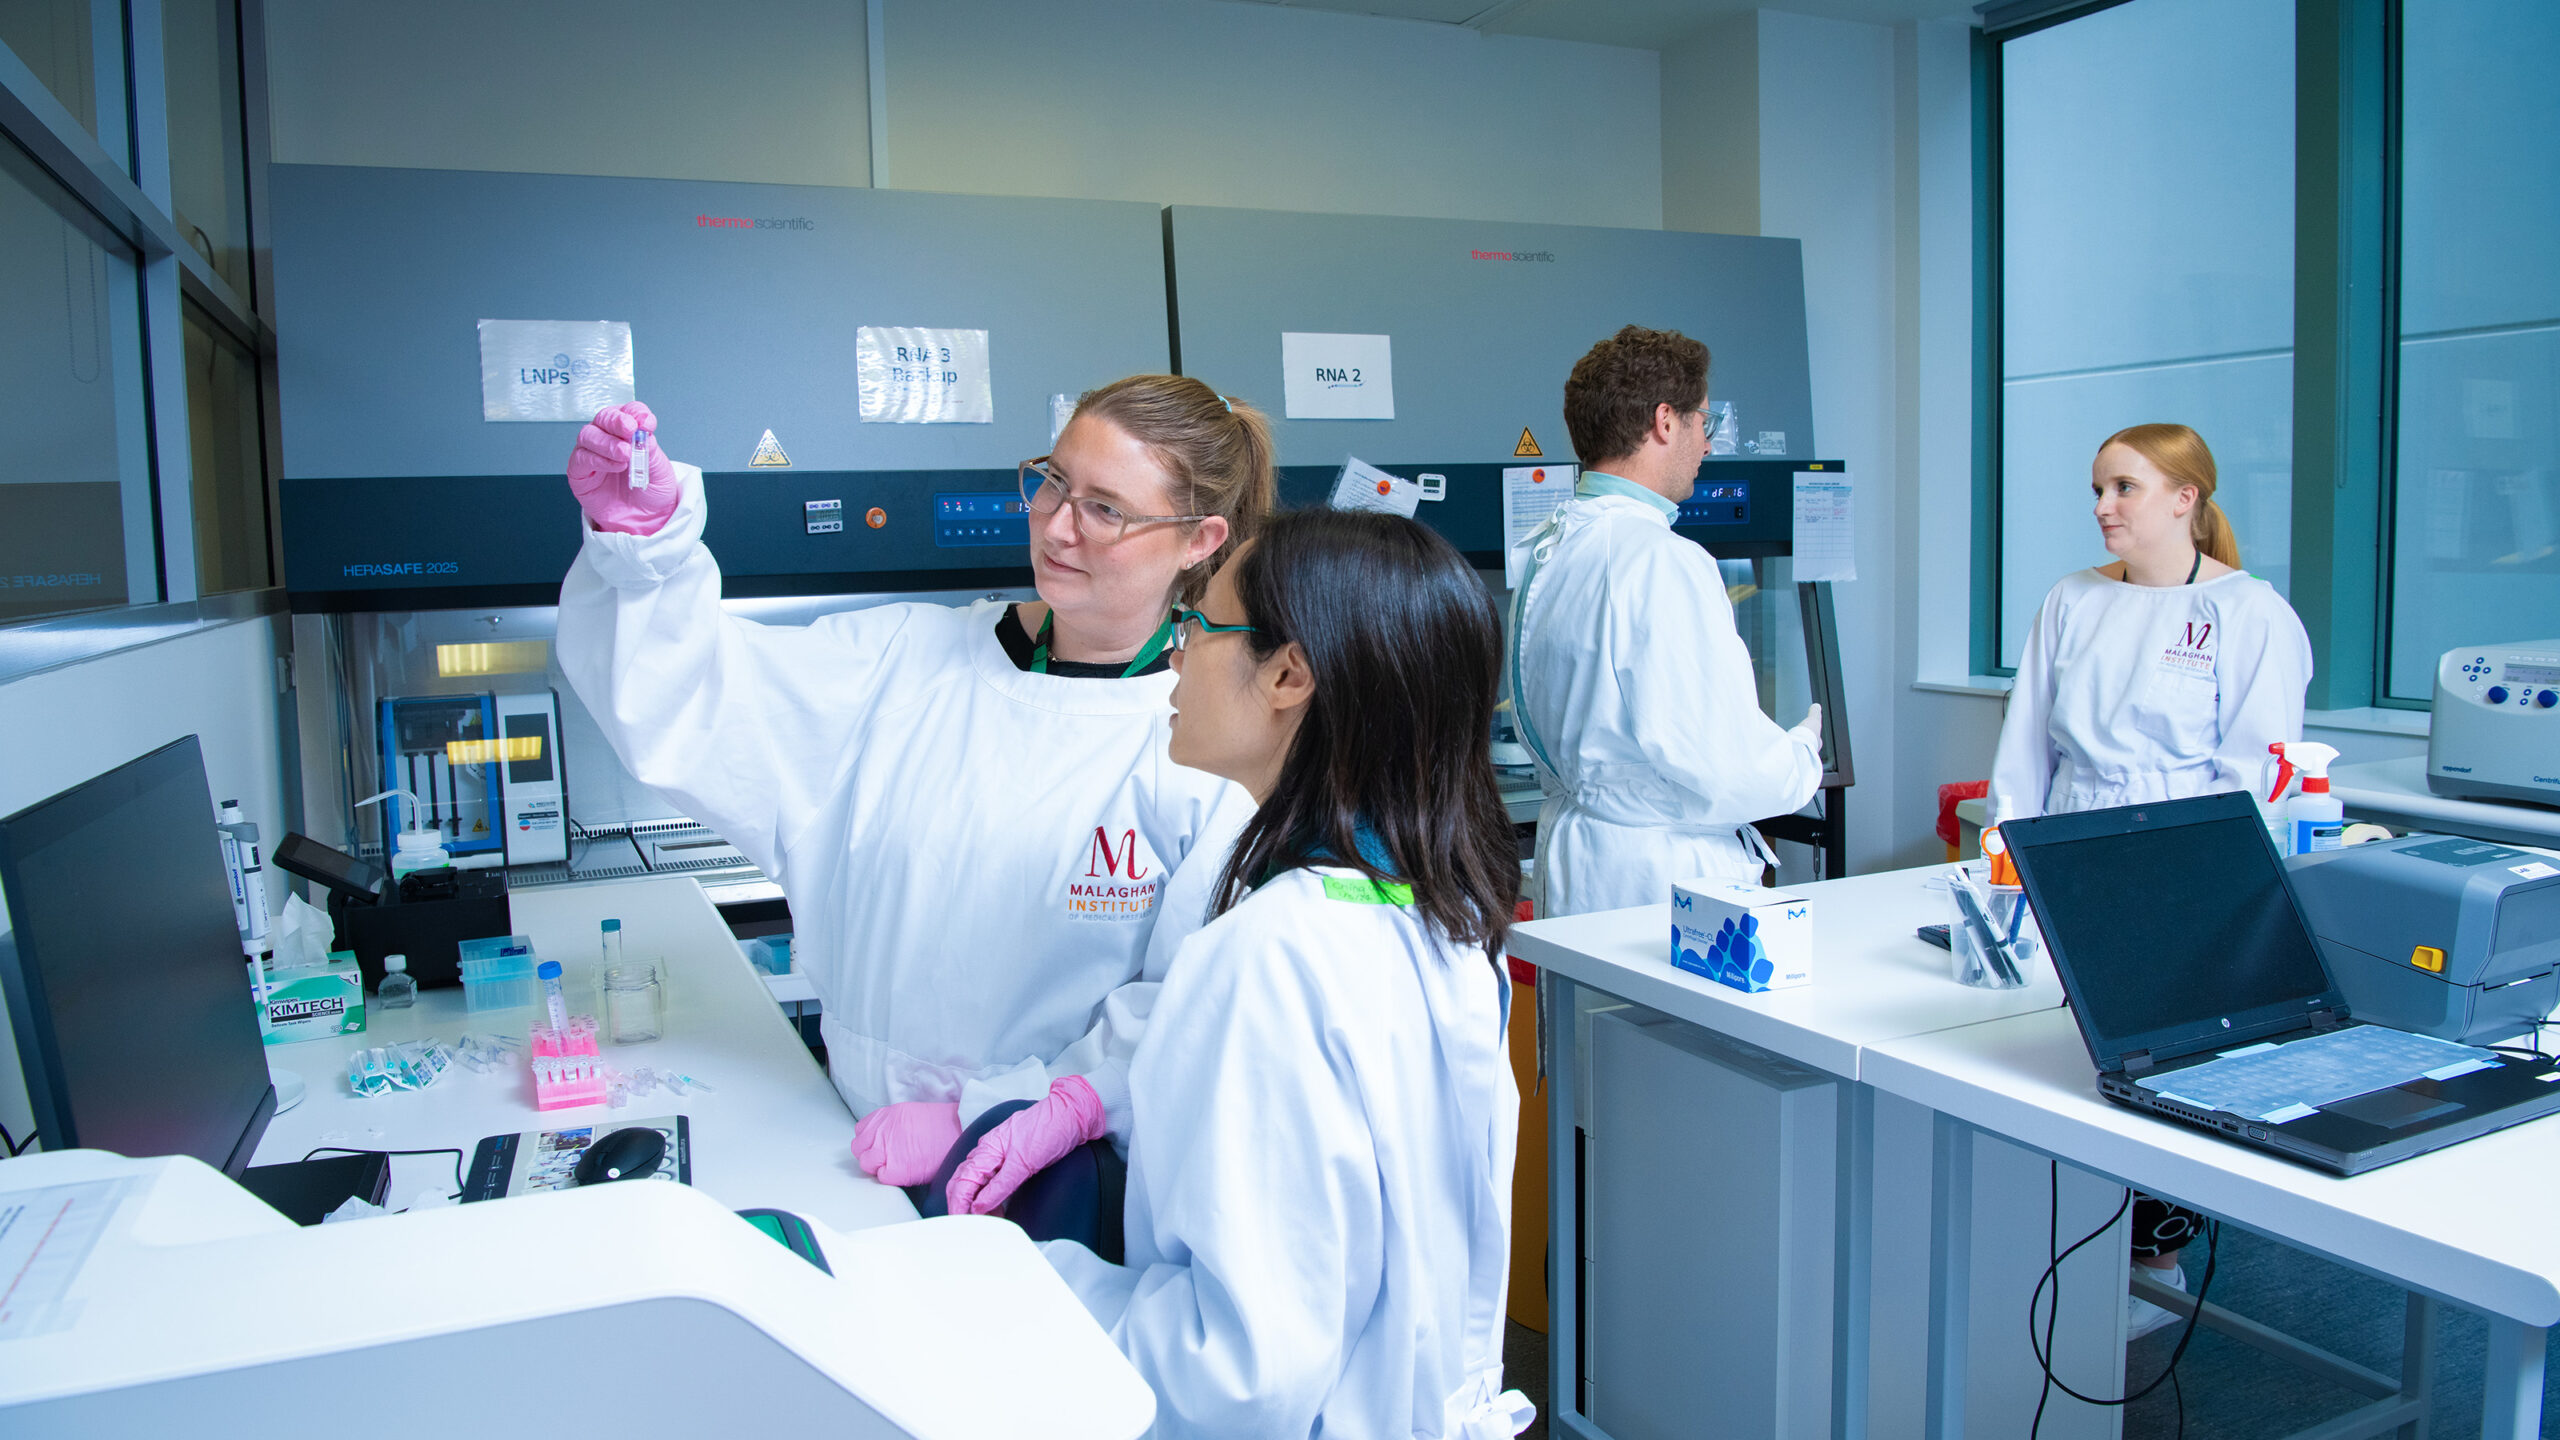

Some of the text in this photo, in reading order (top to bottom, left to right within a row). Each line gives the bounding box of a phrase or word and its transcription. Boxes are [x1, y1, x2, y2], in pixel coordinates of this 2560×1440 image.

[941, 347, 951, 363] 3
[521, 367, 570, 385] LNPs
[1316, 367, 1361, 382] RNA 2
[343, 562, 459, 577] HERASAFE 2025
[2165, 648, 2213, 662] MALAGHAN
[1084, 826, 1148, 880] M
[1070, 883, 1156, 898] MALAGHAN
[1068, 896, 1153, 912] INSTITUTE
[270, 997, 343, 1017] KIMTECH
